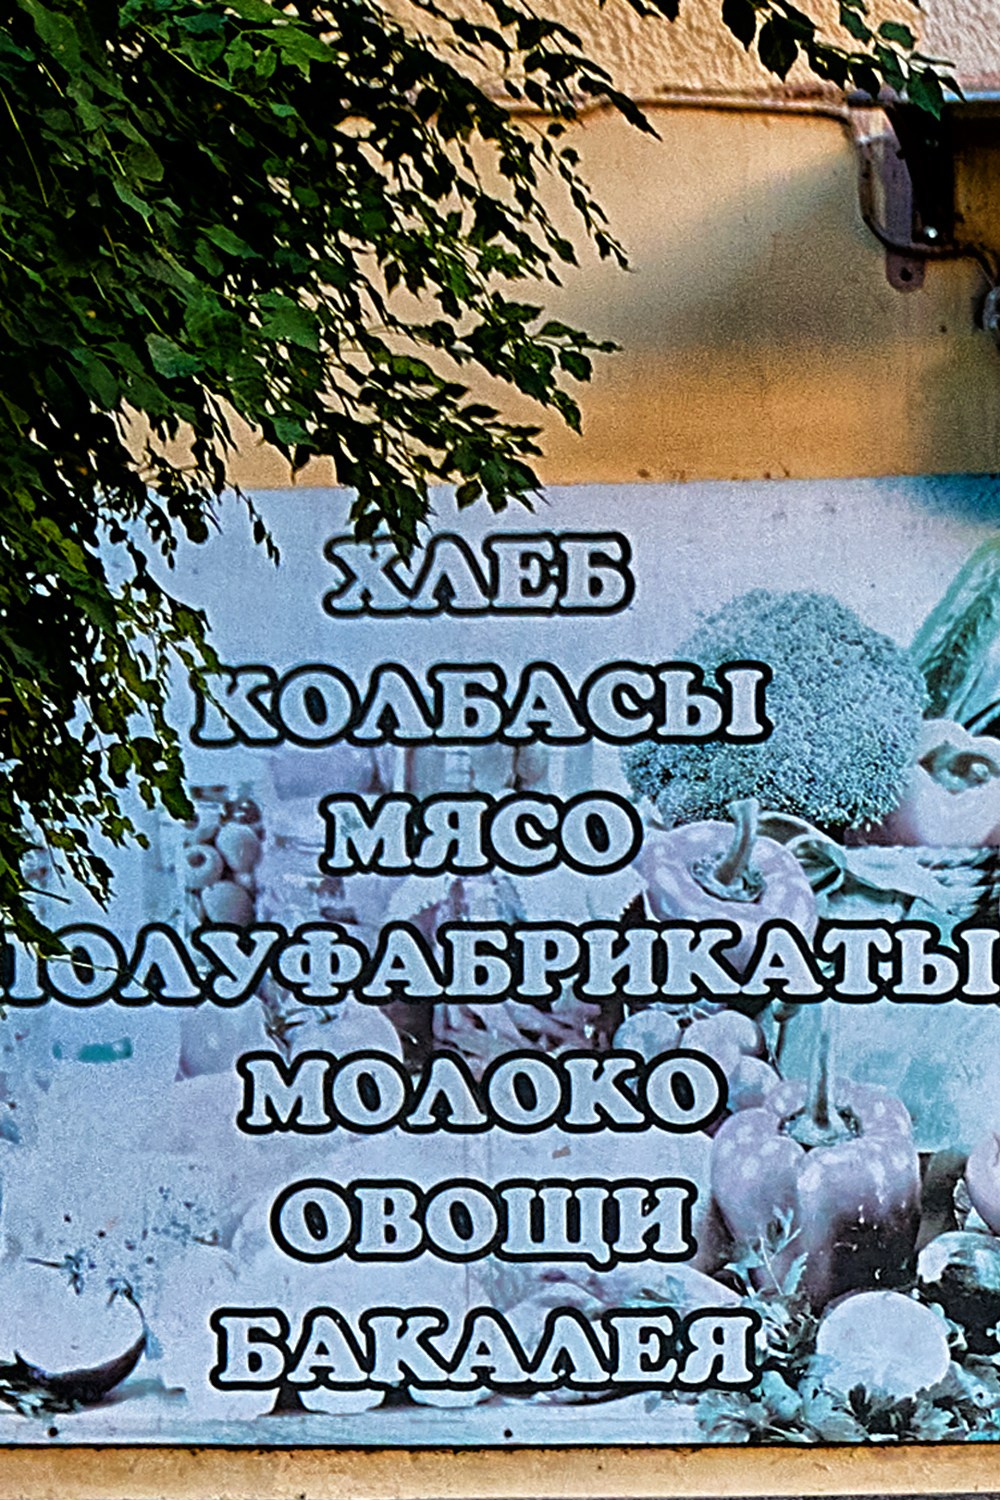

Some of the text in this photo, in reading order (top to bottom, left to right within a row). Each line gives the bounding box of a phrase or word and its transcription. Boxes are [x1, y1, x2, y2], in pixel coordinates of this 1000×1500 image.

[322, 531, 636, 618] ХЛЕБ
[190, 663, 768, 747] КОЛБАСЫ
[319, 790, 643, 876] МЯСО
[236, 1049, 729, 1135] МОЛОКО
[271, 1178, 697, 1271] ОВОЩИ
[210, 1307, 761, 1393] БАКАЛЕЯ
